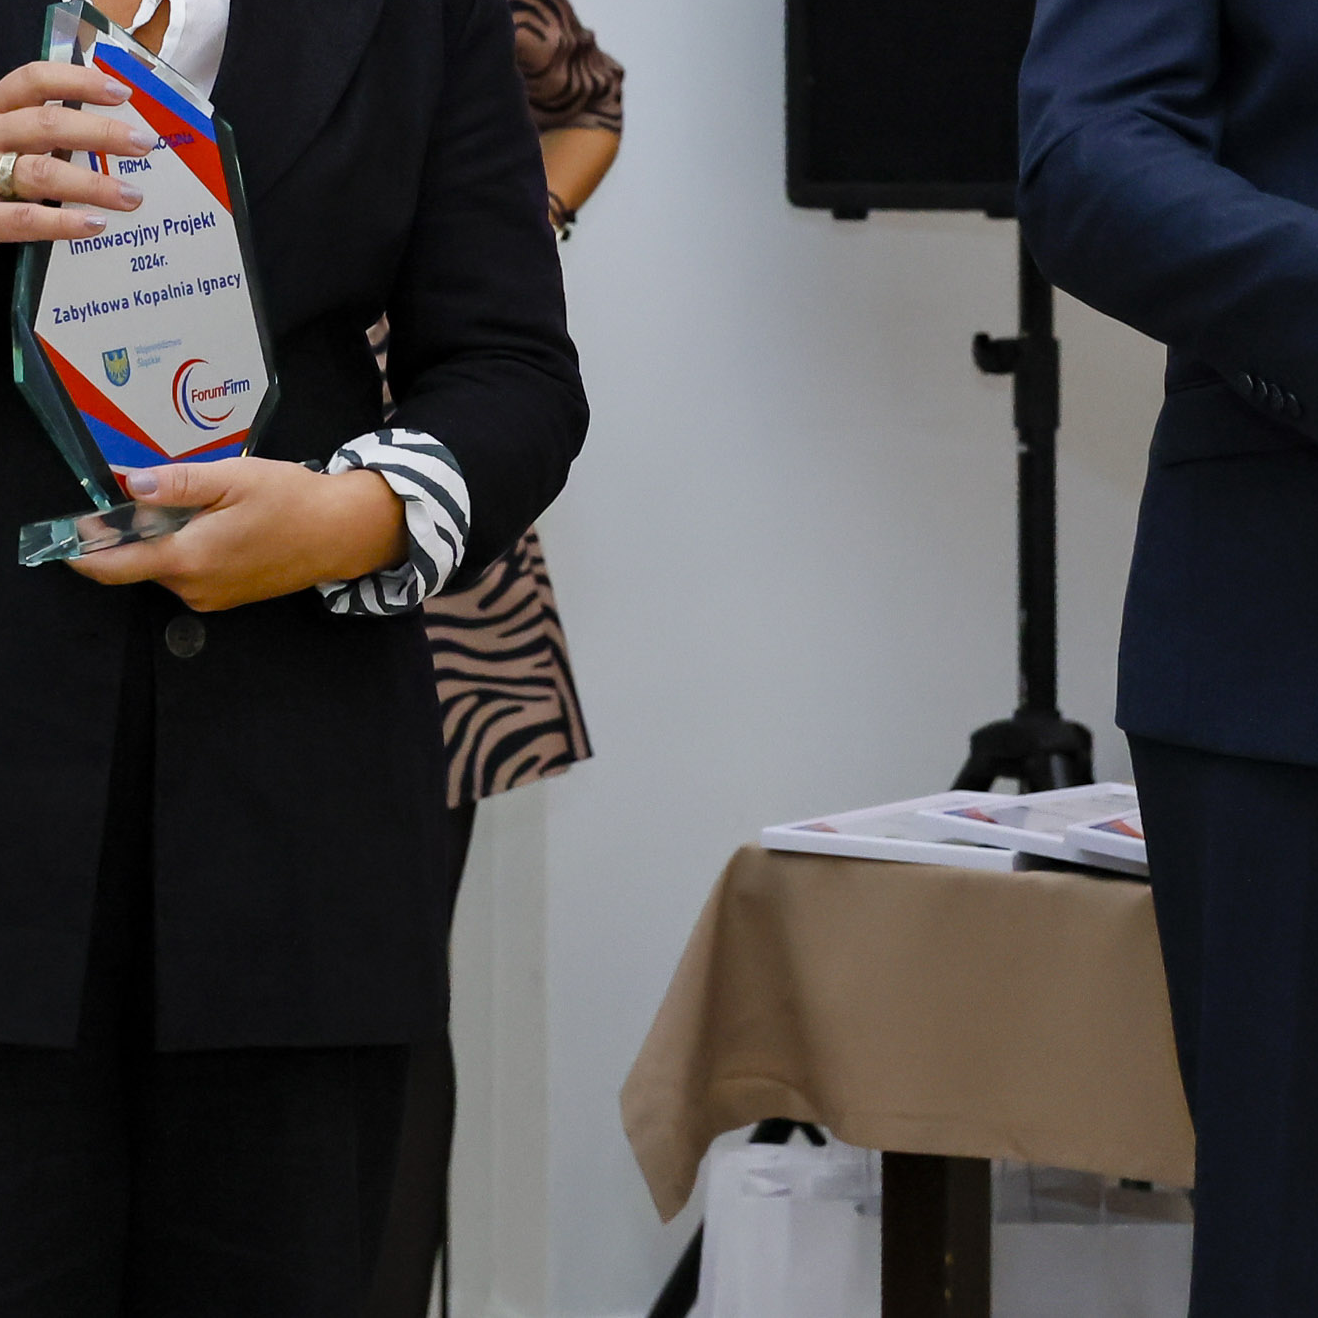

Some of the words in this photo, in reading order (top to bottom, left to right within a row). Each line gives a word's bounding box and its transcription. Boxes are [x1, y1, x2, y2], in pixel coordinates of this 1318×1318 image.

[118, 158, 152, 175] FIRMA
[69, 224, 159, 255] Innowacyjny
[163, 211, 216, 236] Projekt
[130, 253, 169, 272] 2024r.
[52, 296, 130, 324] Zabytkowa
[133, 282, 194, 307] Kopalnia
[197, 273, 241, 295] Ignacy
[191, 378, 250, 403] ForumFirm
